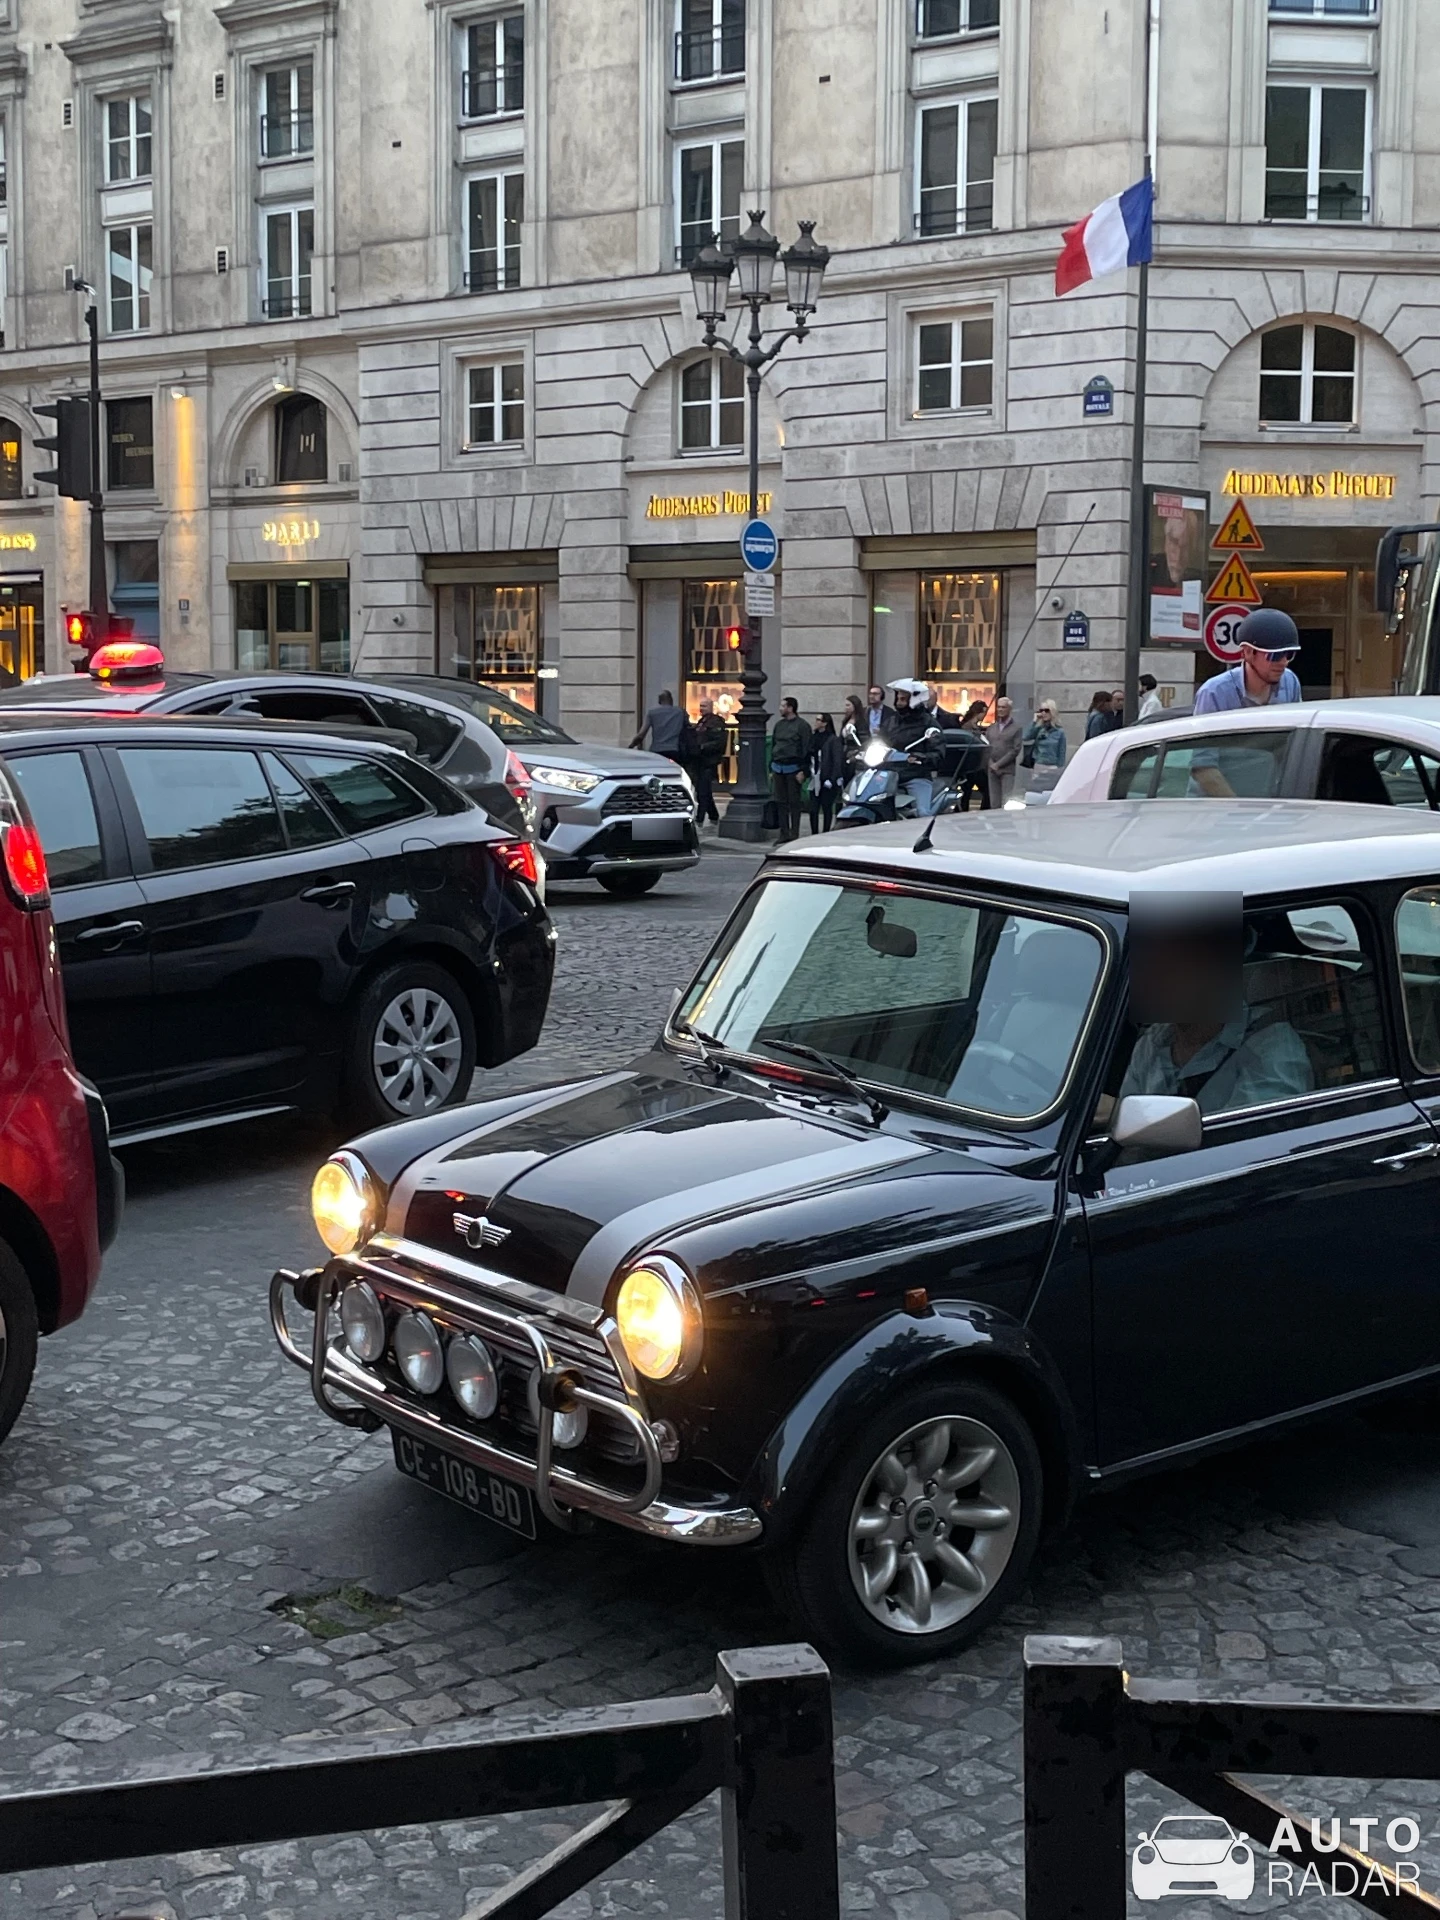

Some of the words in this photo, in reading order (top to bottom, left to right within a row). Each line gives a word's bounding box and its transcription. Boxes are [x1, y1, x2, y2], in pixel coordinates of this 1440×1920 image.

[1222, 468, 1325, 497] AUDEMARS
[1331, 470, 1396, 498] PIGUET
[645, 494, 719, 518] AUDEMARS
[263, 520, 320, 541] MARLI
[1069, 627, 1083, 635] RUE
